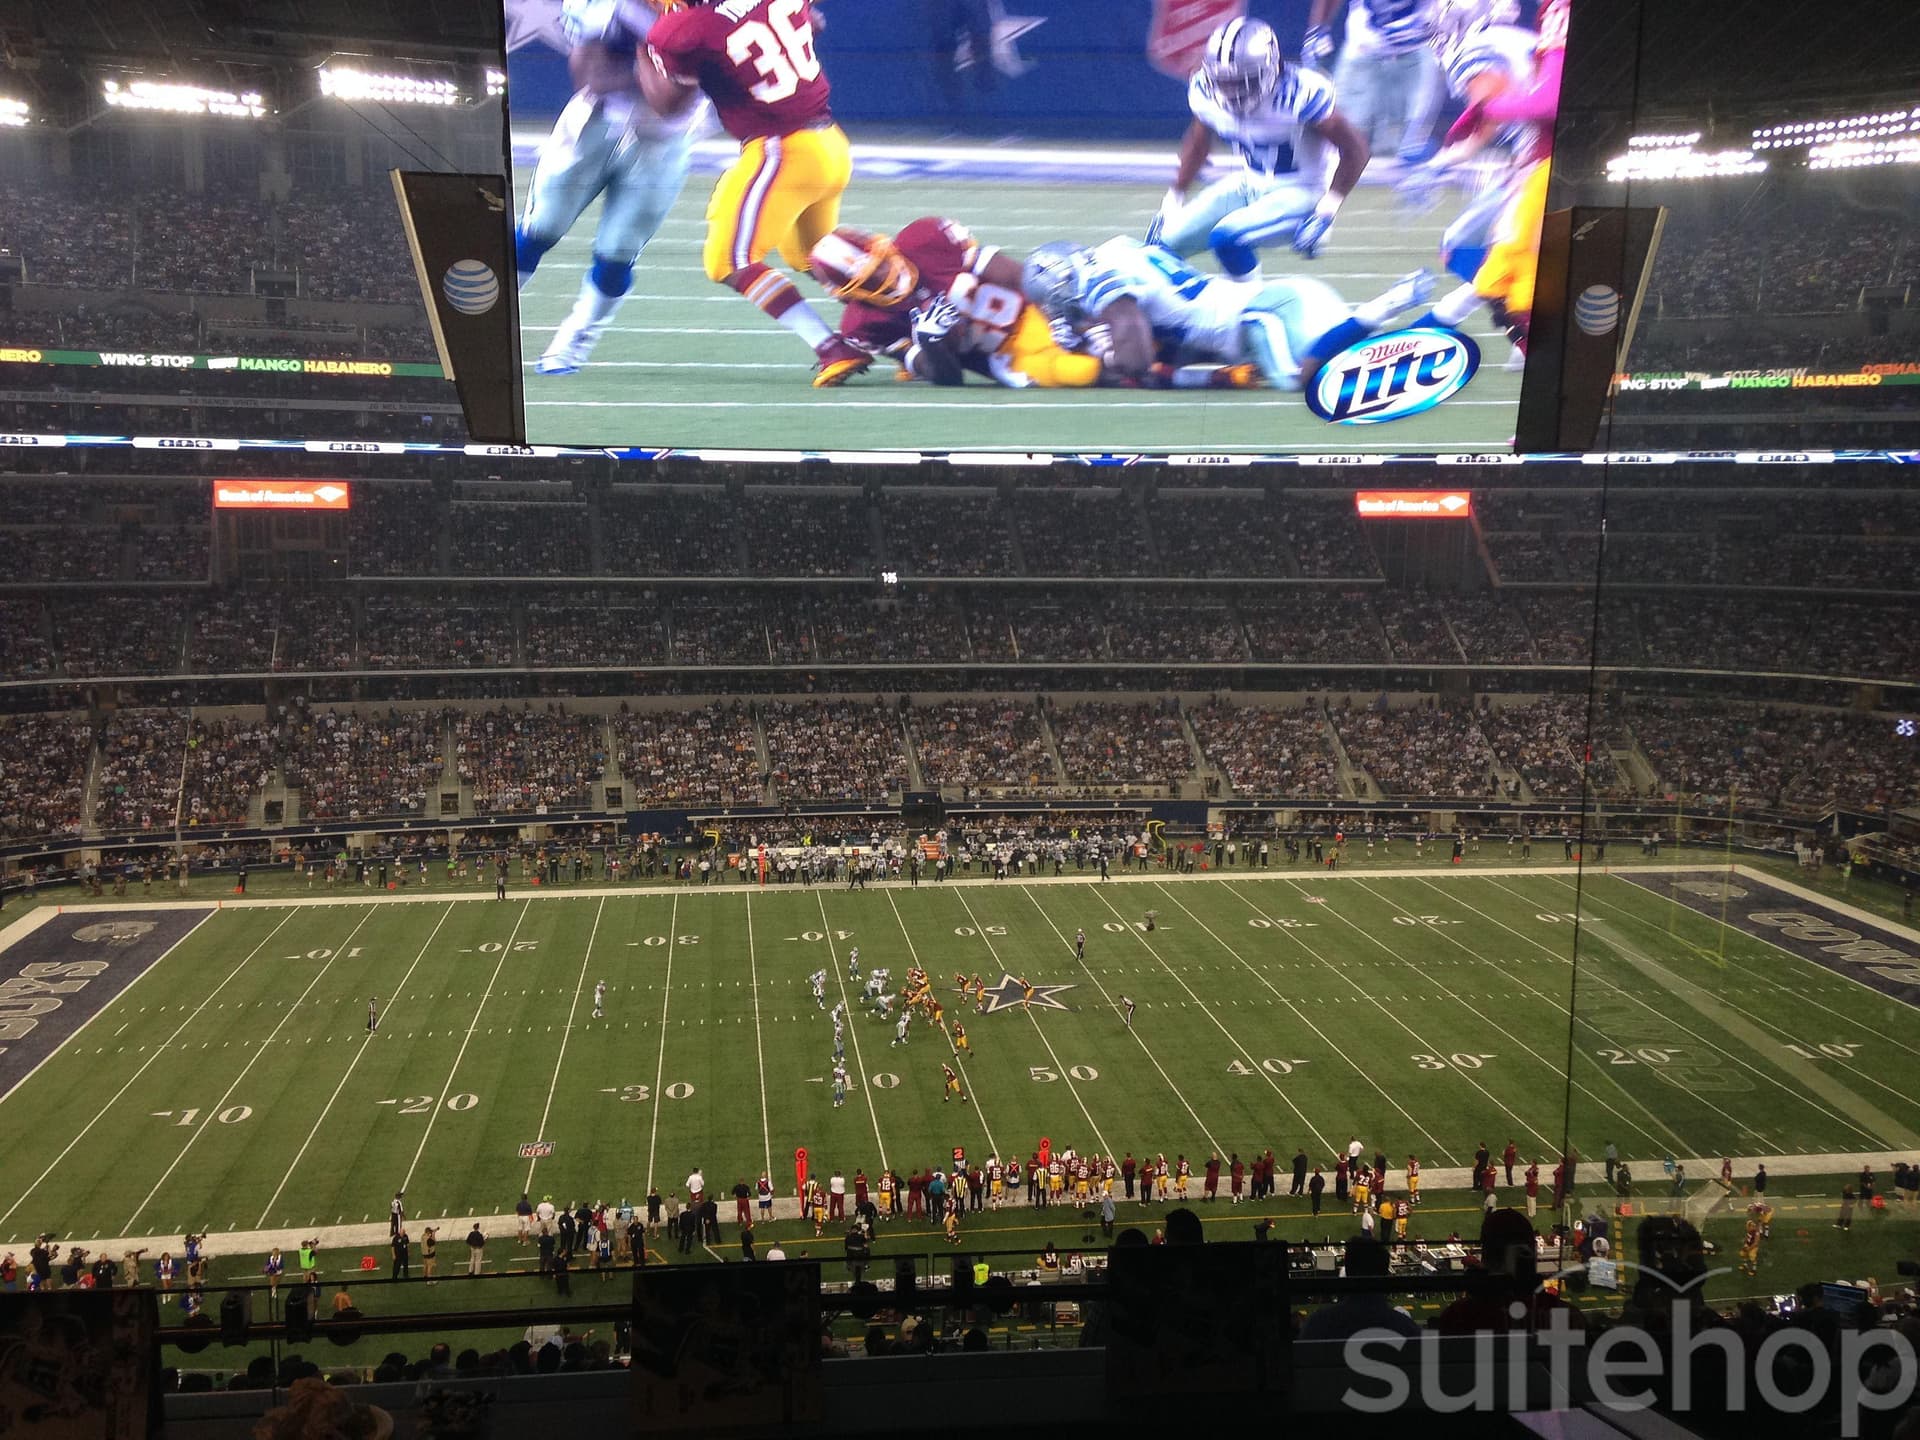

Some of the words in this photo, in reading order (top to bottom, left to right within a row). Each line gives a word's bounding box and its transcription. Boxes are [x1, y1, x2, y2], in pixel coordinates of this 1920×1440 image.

[726, 0, 820, 104] 36
[1360, 341, 1421, 364] Miller
[241, 358, 300, 372] MANGO
[304, 360, 391, 376] HABANERO
[1328, 345, 1456, 423] Lite
[1731, 376, 1790, 389] MANGO
[1792, 373, 1881, 387] HABANERO
[801, 930, 854, 942] 40
[954, 926, 1007, 936] 50
[478, 940, 539, 952] 20
[643, 935, 700, 946] 30
[307, 947, 367, 959] 10
[1597, 1049, 1670, 1065] 20
[1783, 1043, 1855, 1058] 10
[1227, 1058, 1294, 1075] 40
[1410, 1053, 1483, 1070] 30
[1029, 1065, 1099, 1082] 50
[620, 1082, 695, 1102] 30
[398, 1093, 479, 1114] 20
[170, 1106, 253, 1127] 10
[522, 1146, 552, 1157] NFL
[954, 1148, 963, 1159] 2
[993, 1170, 1001, 1180] 15
[882, 1178, 891, 1190] 12
